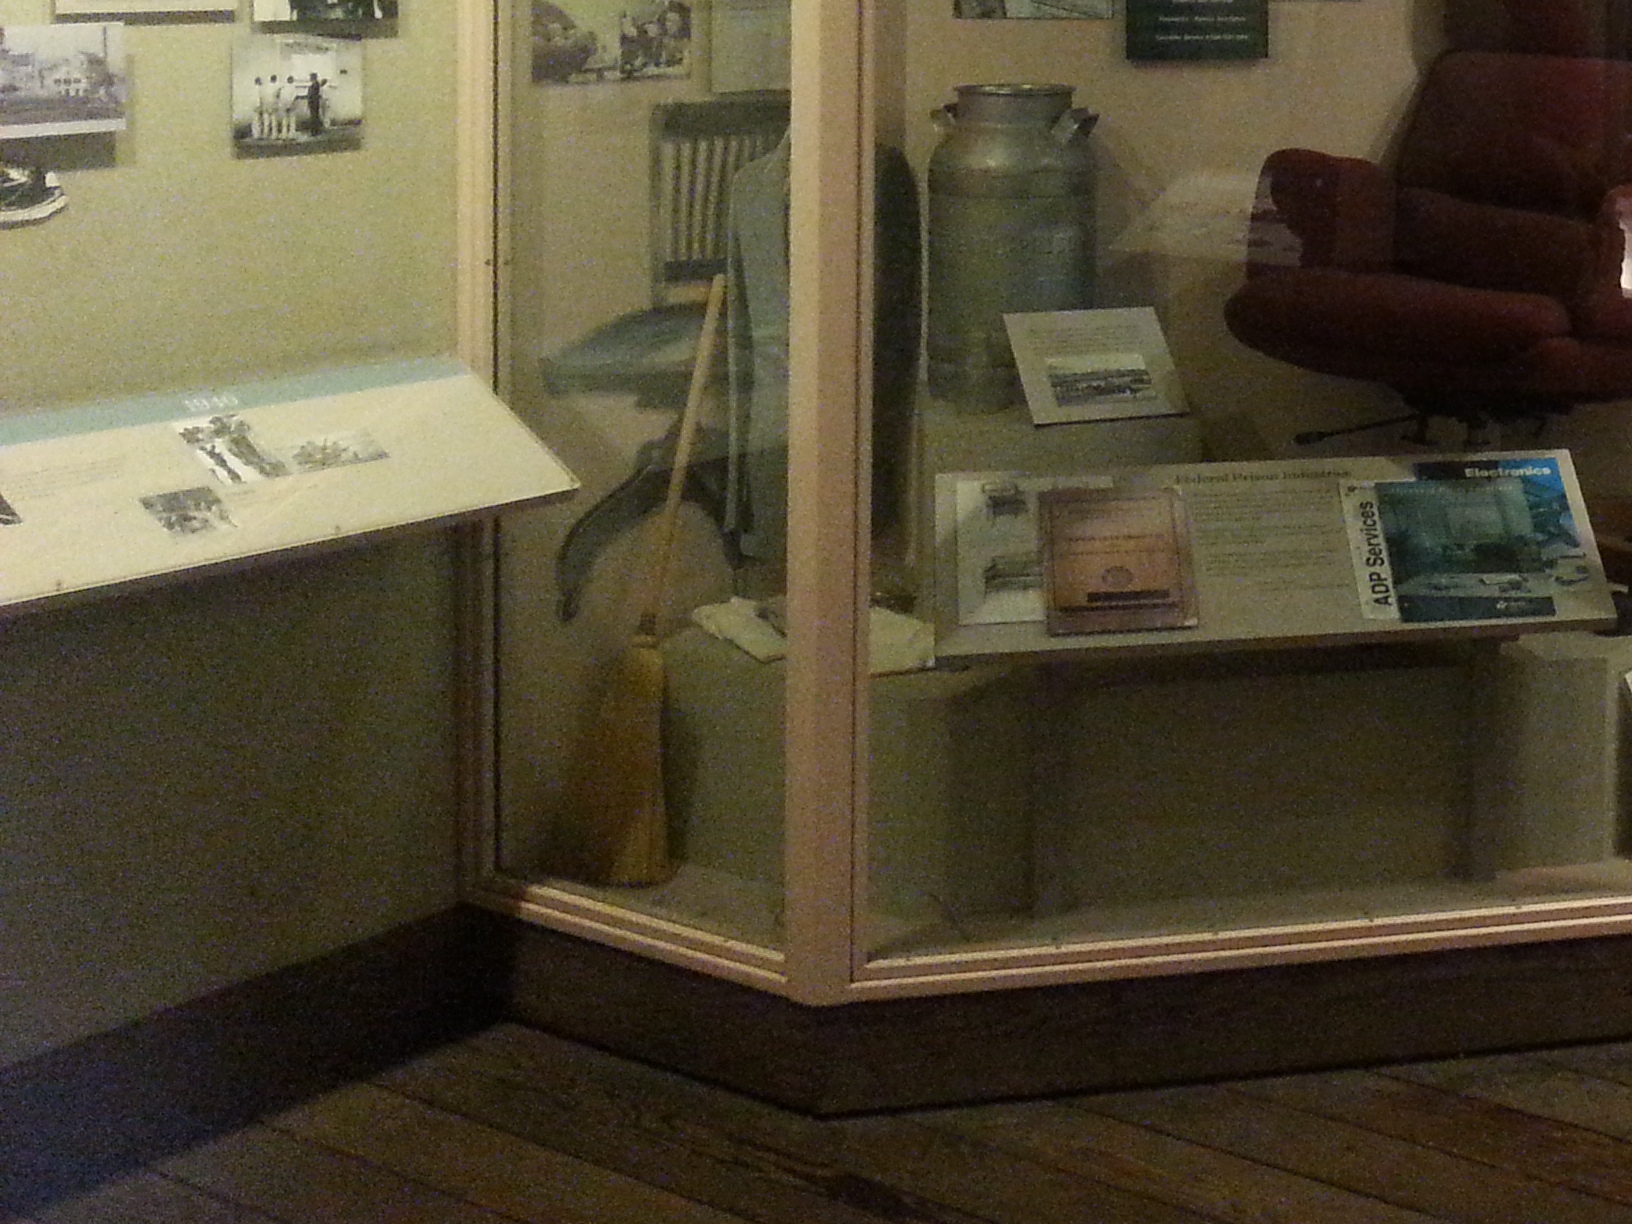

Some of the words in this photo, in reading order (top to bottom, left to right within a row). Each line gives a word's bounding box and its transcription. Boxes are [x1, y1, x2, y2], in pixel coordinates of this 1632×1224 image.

[1464, 464, 1552, 478] Electronics
[1358, 501, 1385, 568] Services
[1367, 570, 1393, 607] ADP
